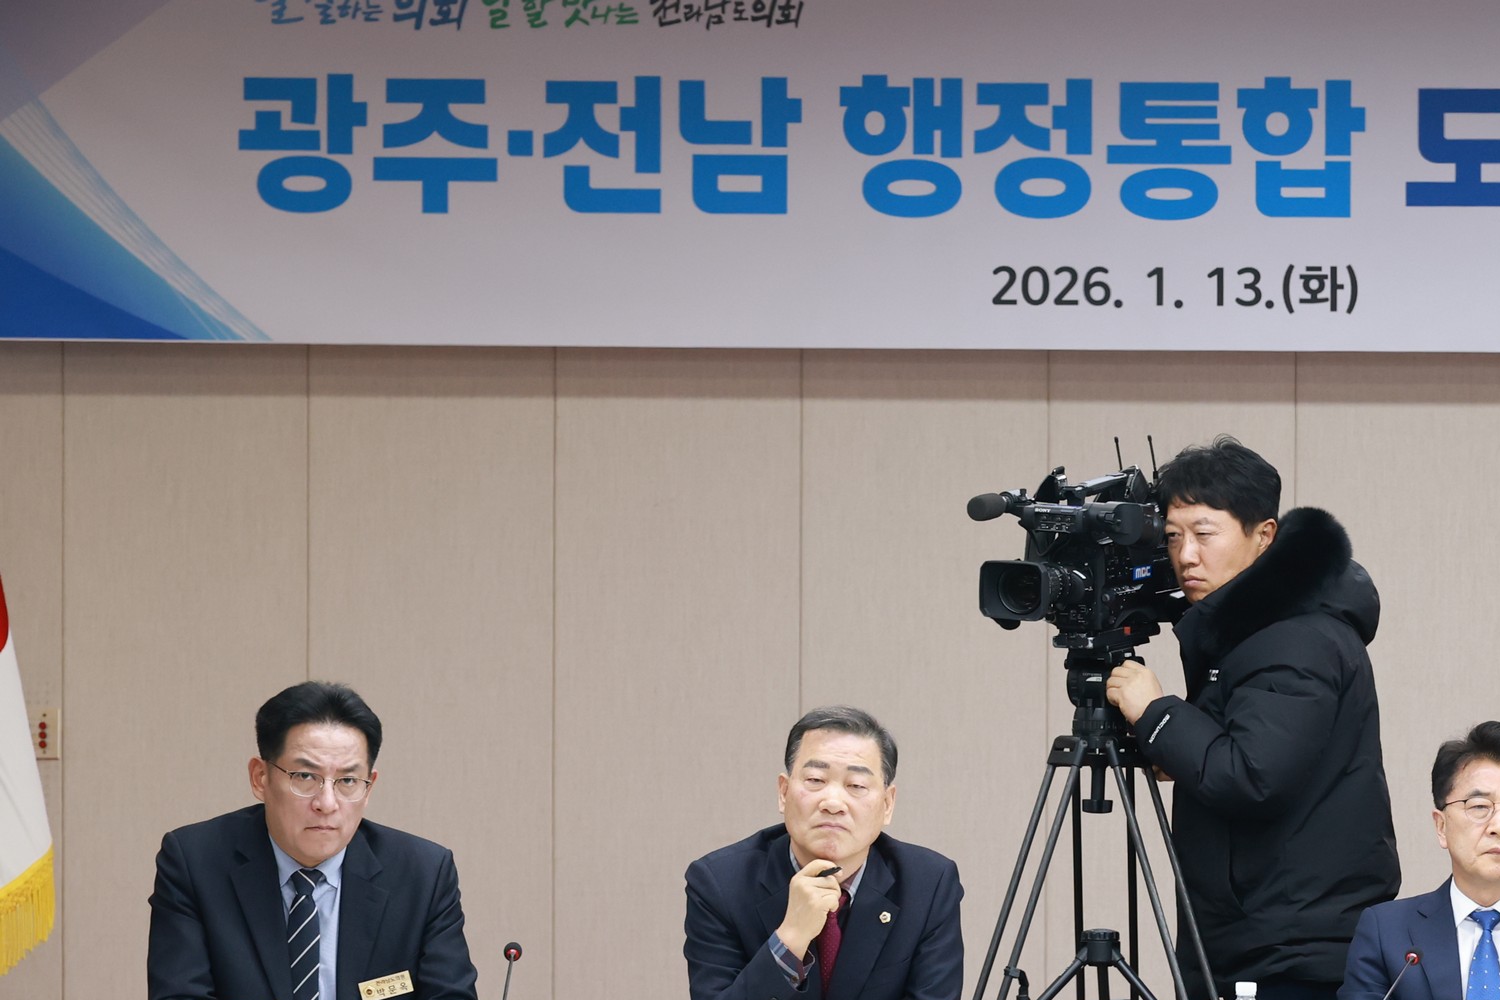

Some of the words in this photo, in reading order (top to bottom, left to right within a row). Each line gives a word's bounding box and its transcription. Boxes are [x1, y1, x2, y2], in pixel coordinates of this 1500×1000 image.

[239, 74, 803, 214] 광주·전남
[839, 74, 1366, 220] 행정통합
[991, 265, 1124, 309] 2026.
[1146, 266, 1184, 310] 1.
[1206, 263, 1359, 315] 13.(화)
